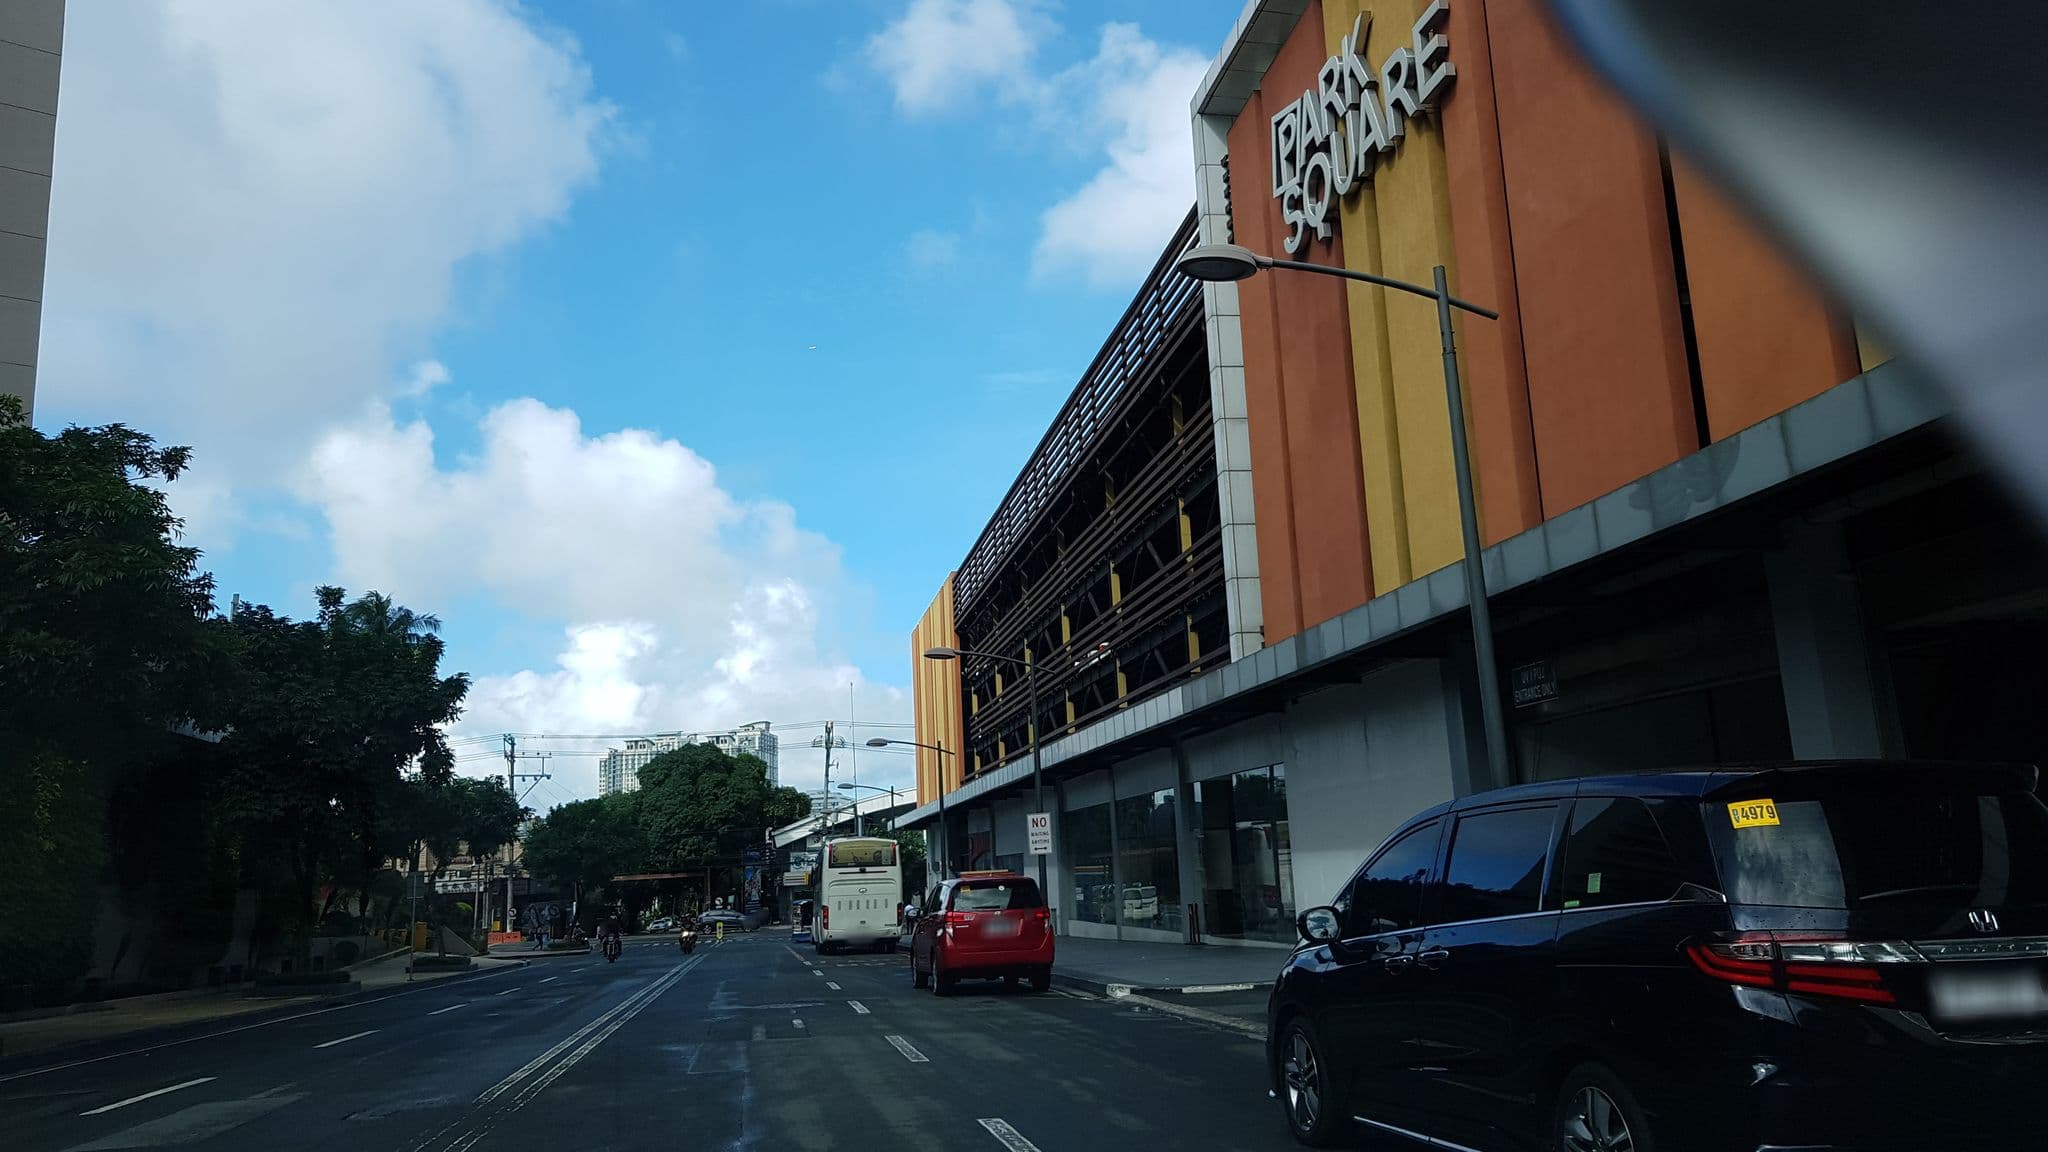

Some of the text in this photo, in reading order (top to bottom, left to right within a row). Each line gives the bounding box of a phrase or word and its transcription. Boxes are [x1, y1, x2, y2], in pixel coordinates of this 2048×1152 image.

[1272, 10, 1377, 197] PARK
[1283, 0, 1456, 253] SQUARE
[1032, 817, 1047, 828] NO
[1741, 805, 1776, 820] 4979
